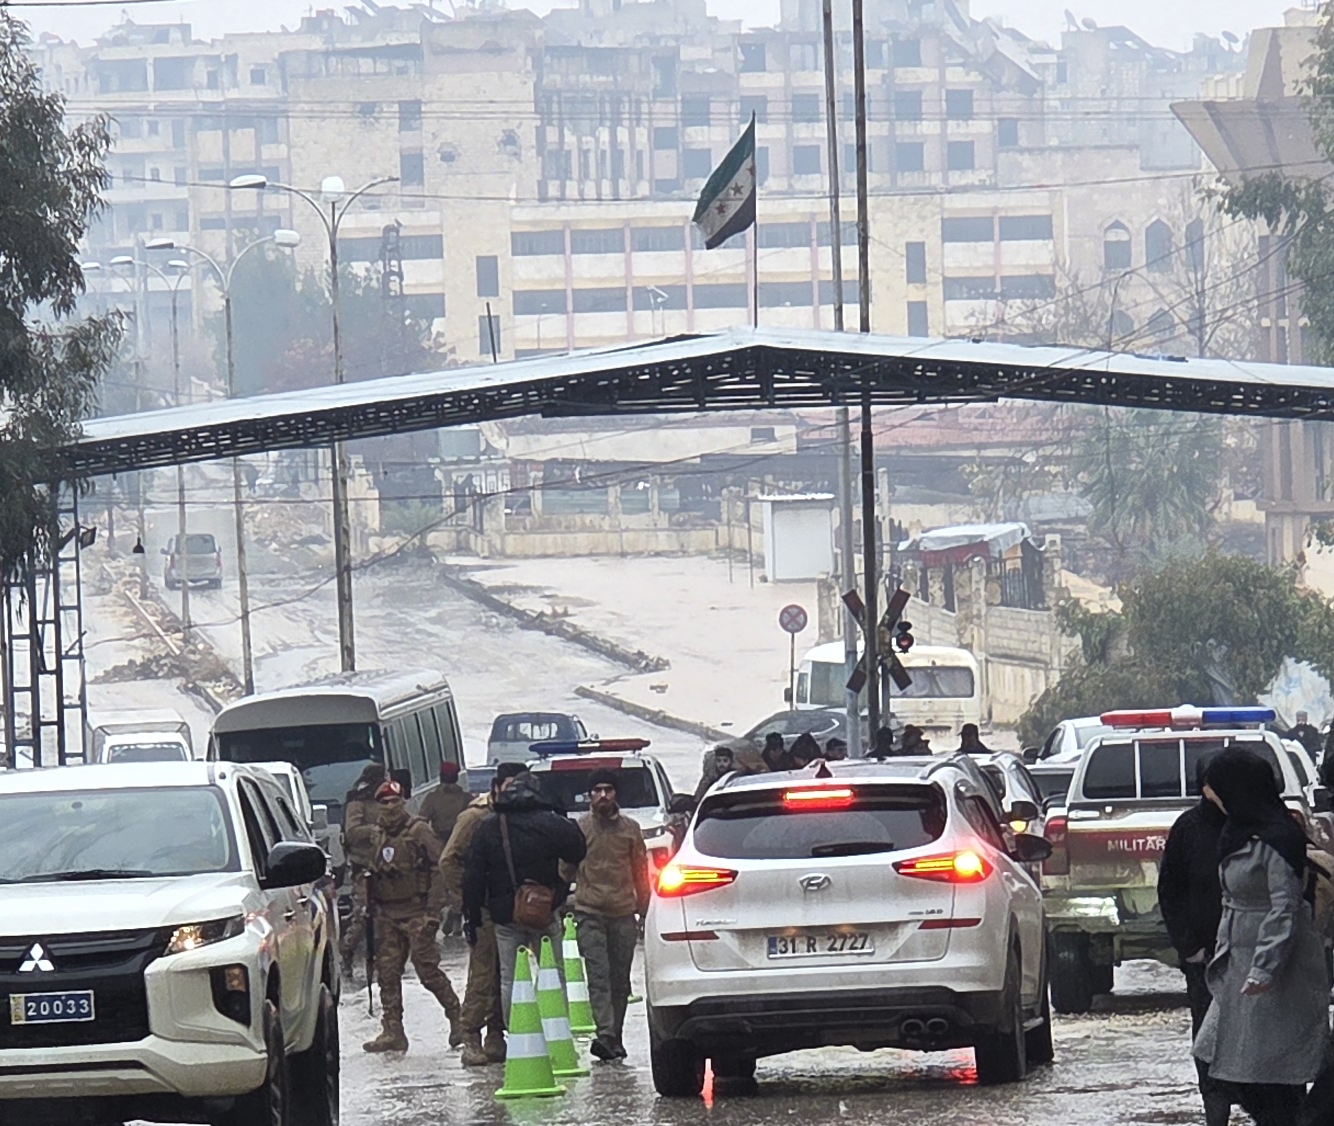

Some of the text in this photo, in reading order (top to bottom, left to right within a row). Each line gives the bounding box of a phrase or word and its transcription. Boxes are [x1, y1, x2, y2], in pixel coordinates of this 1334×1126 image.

[1107, 838, 1167, 851] MILITAR
[778, 933, 869, 954] 31 R 2727
[27, 1000, 90, 1016] 20033
